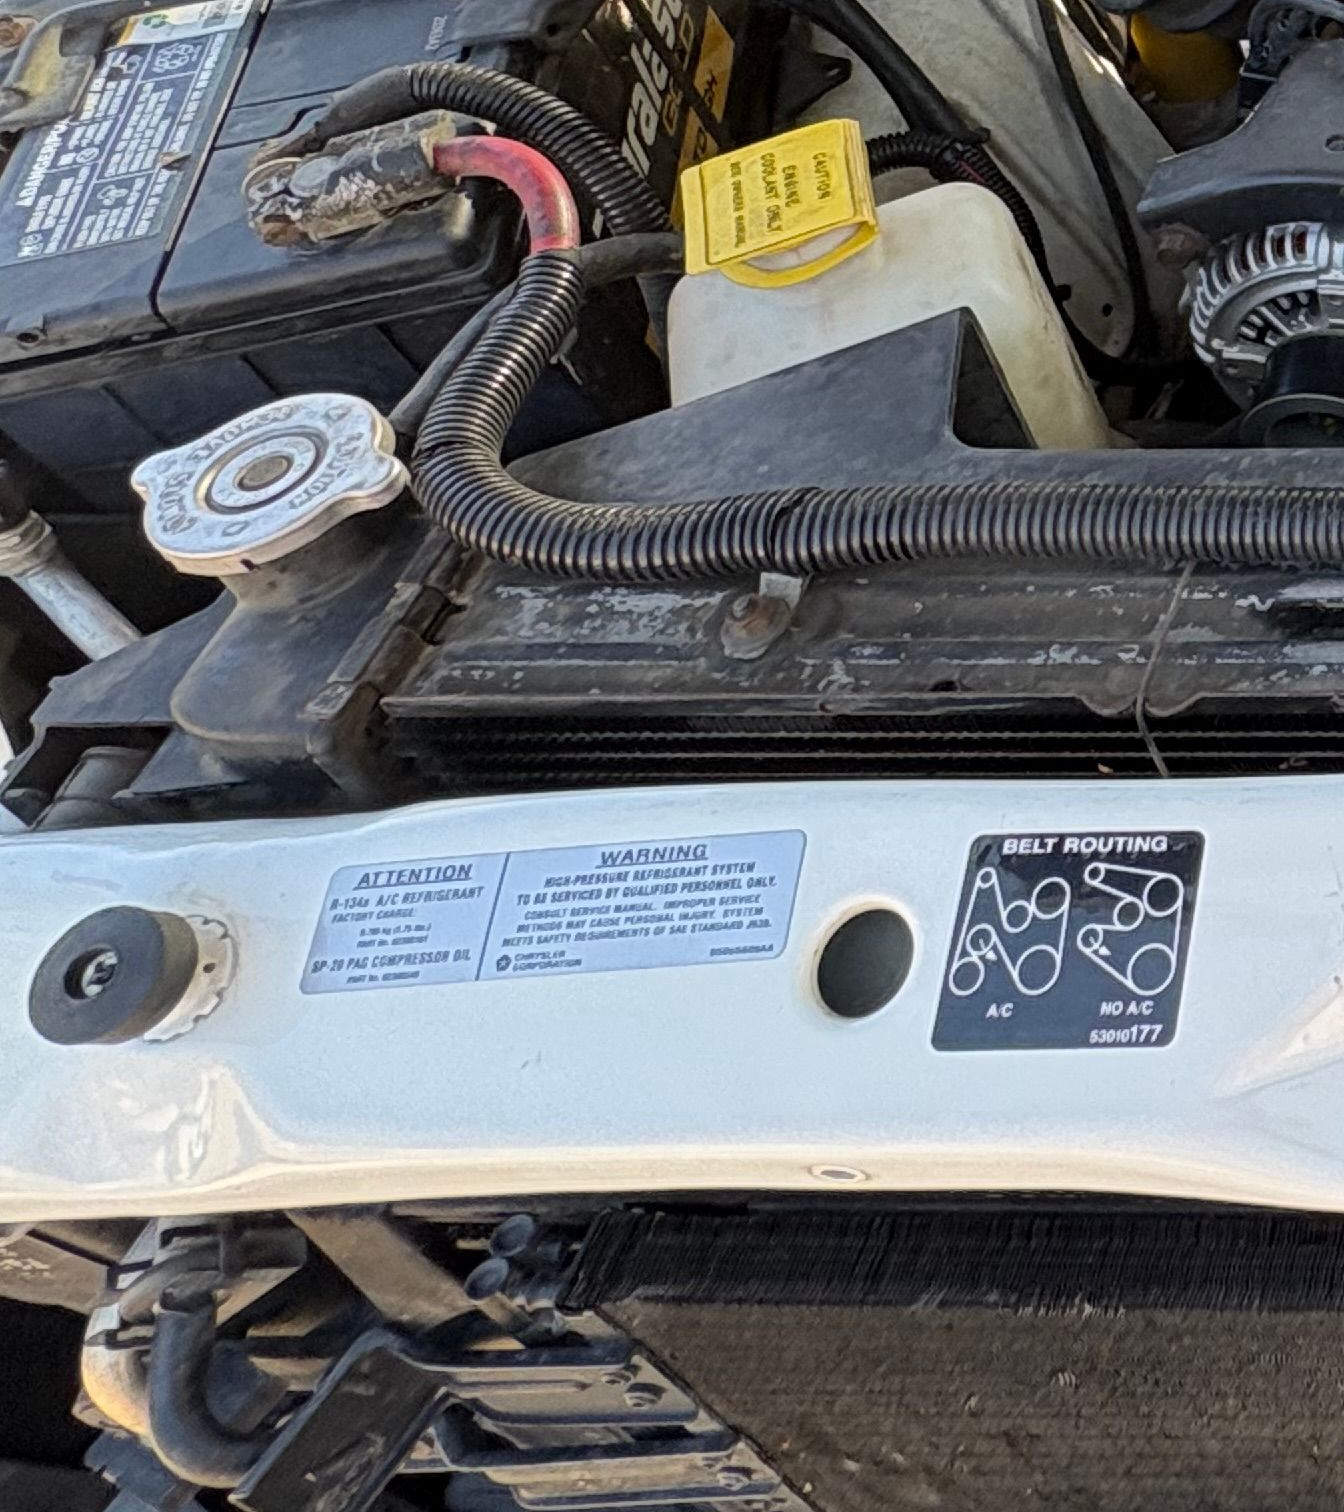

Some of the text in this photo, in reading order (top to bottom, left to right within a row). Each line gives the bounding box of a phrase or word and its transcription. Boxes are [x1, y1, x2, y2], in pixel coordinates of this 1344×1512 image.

[783, 165, 803, 208] ENGINE
[812, 151, 832, 201] CAUTION
[760, 152, 783, 233] COOLANT ONLY
[598, 843, 708, 865] WARNING
[1002, 835, 1169, 855] BELT ROUTING
[358, 863, 472, 885] ATTENTION
[543, 861, 756, 888] HIGH-PRESSURE REFRIGERANT SYSTEM
[375, 893, 399, 906] A/C
[401, 886, 484, 903] REFRIGERANT
[515, 894, 531, 906] TO
[532, 893, 548, 904] BE
[549, 889, 603, 903] SERVICED
[604, 887, 619, 898] BY
[621, 882, 678, 897] QUALIFIED
[680, 878, 743, 893] PERSONNEL
[663, 897, 715, 910] IMPROPER
[565, 919, 586, 929] MAY
[623, 913, 675, 925] PERSONAL
[535, 933, 571, 944] SAFETY
[371, 950, 450, 967] COMPRESSOR
[452, 948, 472, 961] OIL
[1100, 1000, 1155, 1016] NO A/C
[1088, 1023, 1164, 1044] 53010177
